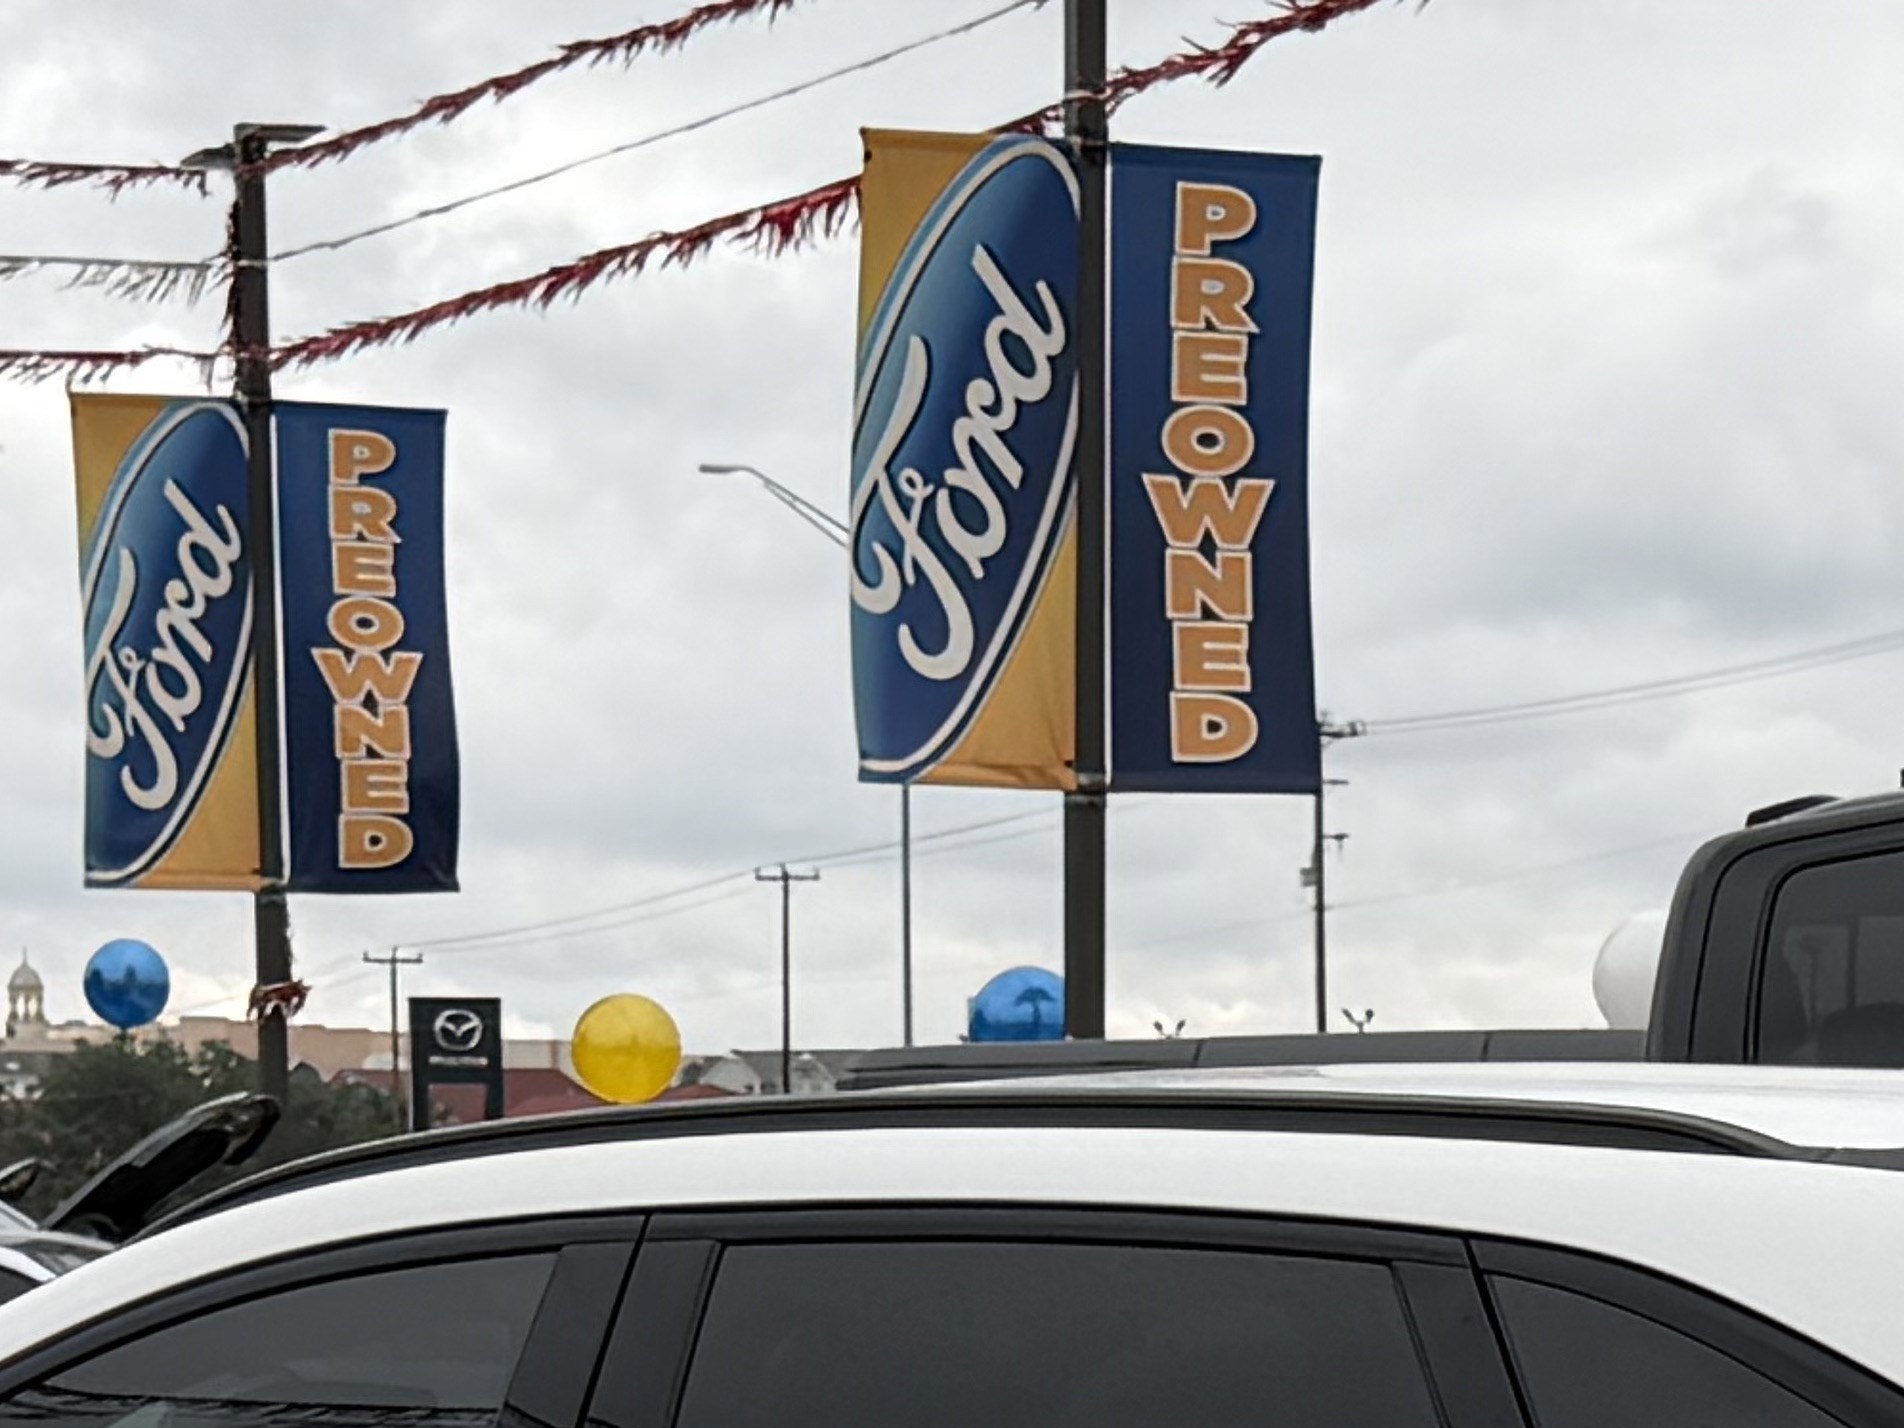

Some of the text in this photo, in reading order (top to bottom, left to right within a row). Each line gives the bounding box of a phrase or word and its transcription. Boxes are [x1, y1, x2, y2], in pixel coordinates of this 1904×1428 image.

[88, 478, 242, 810] Ford
[310, 428, 424, 868] PREOWNED
[851, 243, 1066, 680] Ford
[1141, 181, 1275, 763] PREOWNED
